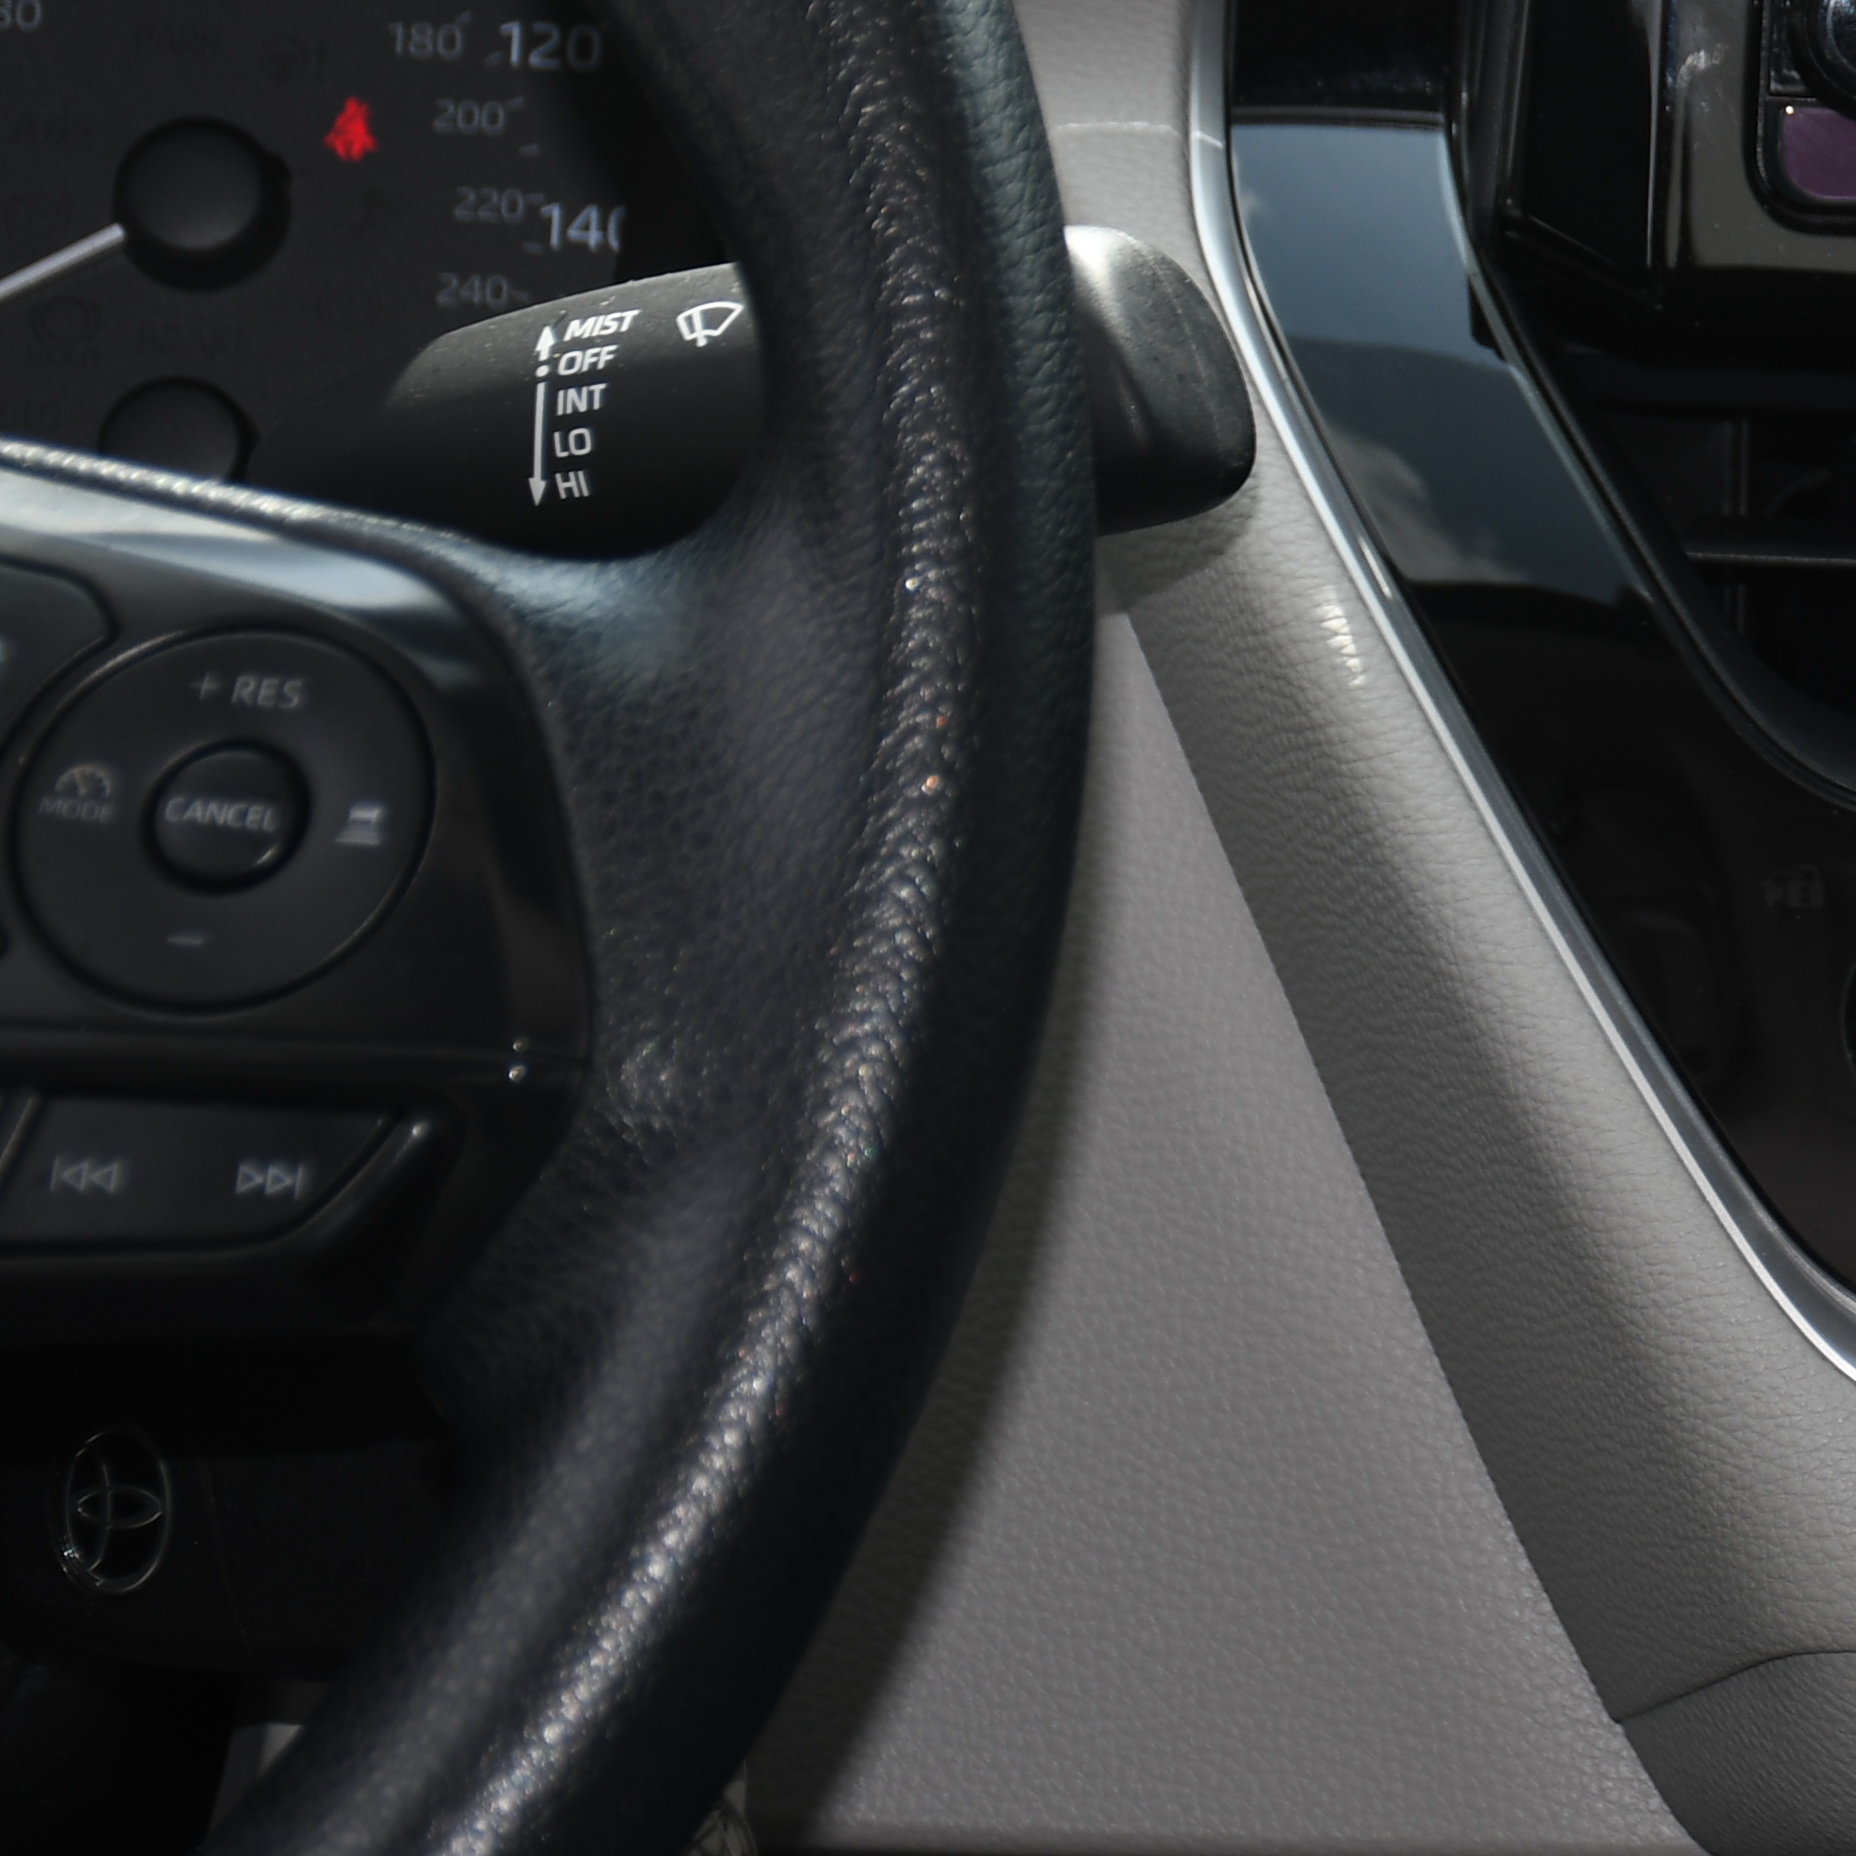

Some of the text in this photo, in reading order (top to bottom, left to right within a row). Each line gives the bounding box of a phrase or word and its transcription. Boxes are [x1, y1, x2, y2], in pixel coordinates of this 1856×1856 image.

[389, 20, 463, 60] 180
[499, 19, 603, 71] 120
[432, 98, 507, 136] 200
[452, 185, 526, 224] 220
[434, 271, 509, 310] 240
[563, 309, 641, 342] MIST
[556, 344, 619, 376] OFF
[556, 383, 608, 416] INT
[553, 427, 595, 458] LO
[554, 469, 591, 500] HI
[230, 674, 304, 710] RES
[38, 795, 117, 825] MODE
[164, 795, 282, 834] CANCEL
